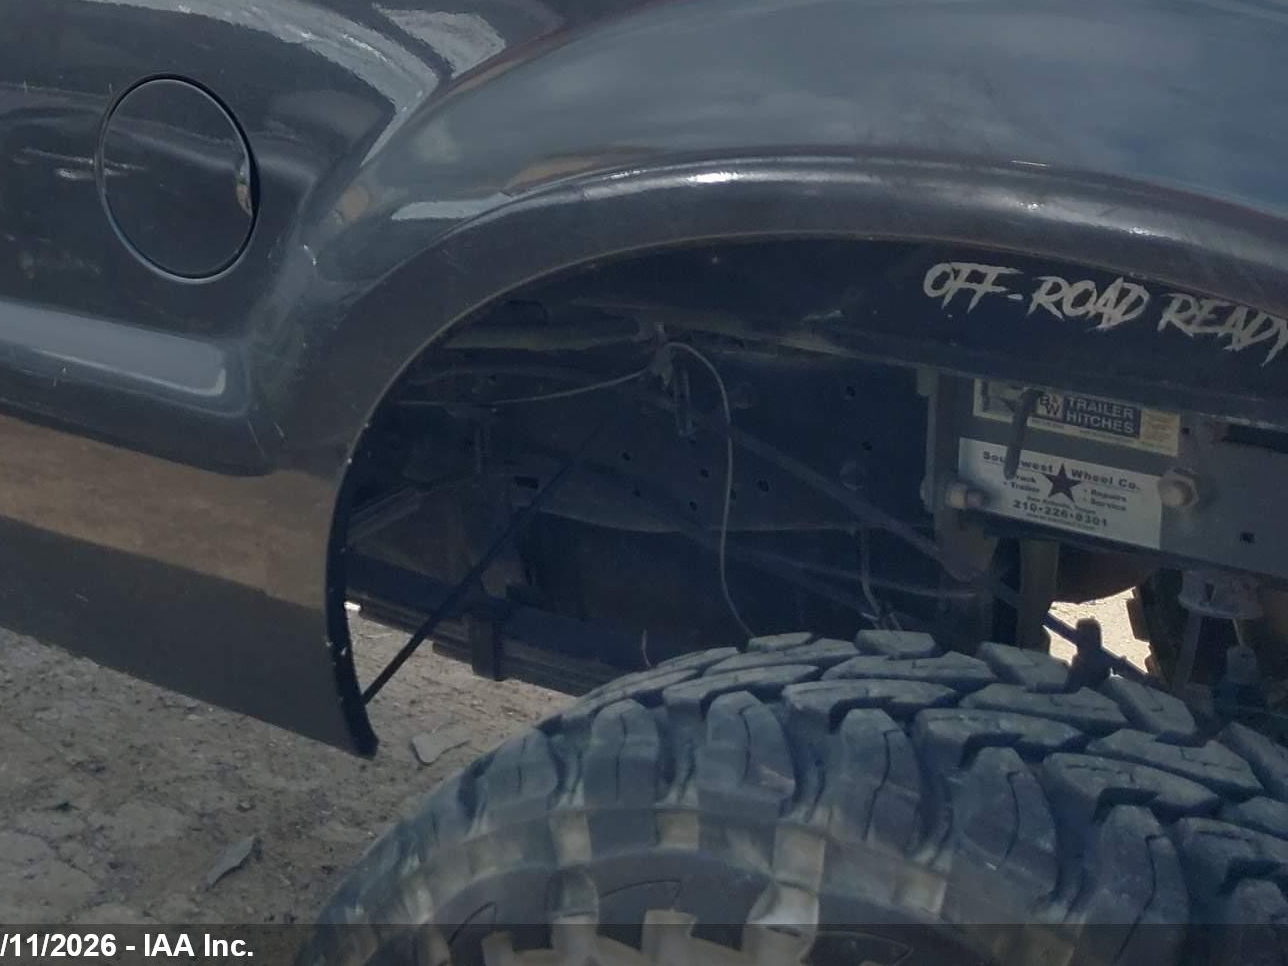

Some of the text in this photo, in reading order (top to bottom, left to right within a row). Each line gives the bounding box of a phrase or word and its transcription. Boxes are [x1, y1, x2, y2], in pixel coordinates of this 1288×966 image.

[1068, 396, 1134, 420] TRAILER
[1067, 410, 1134, 433] HITCHES
[1071, 468, 1114, 485] Wheel
